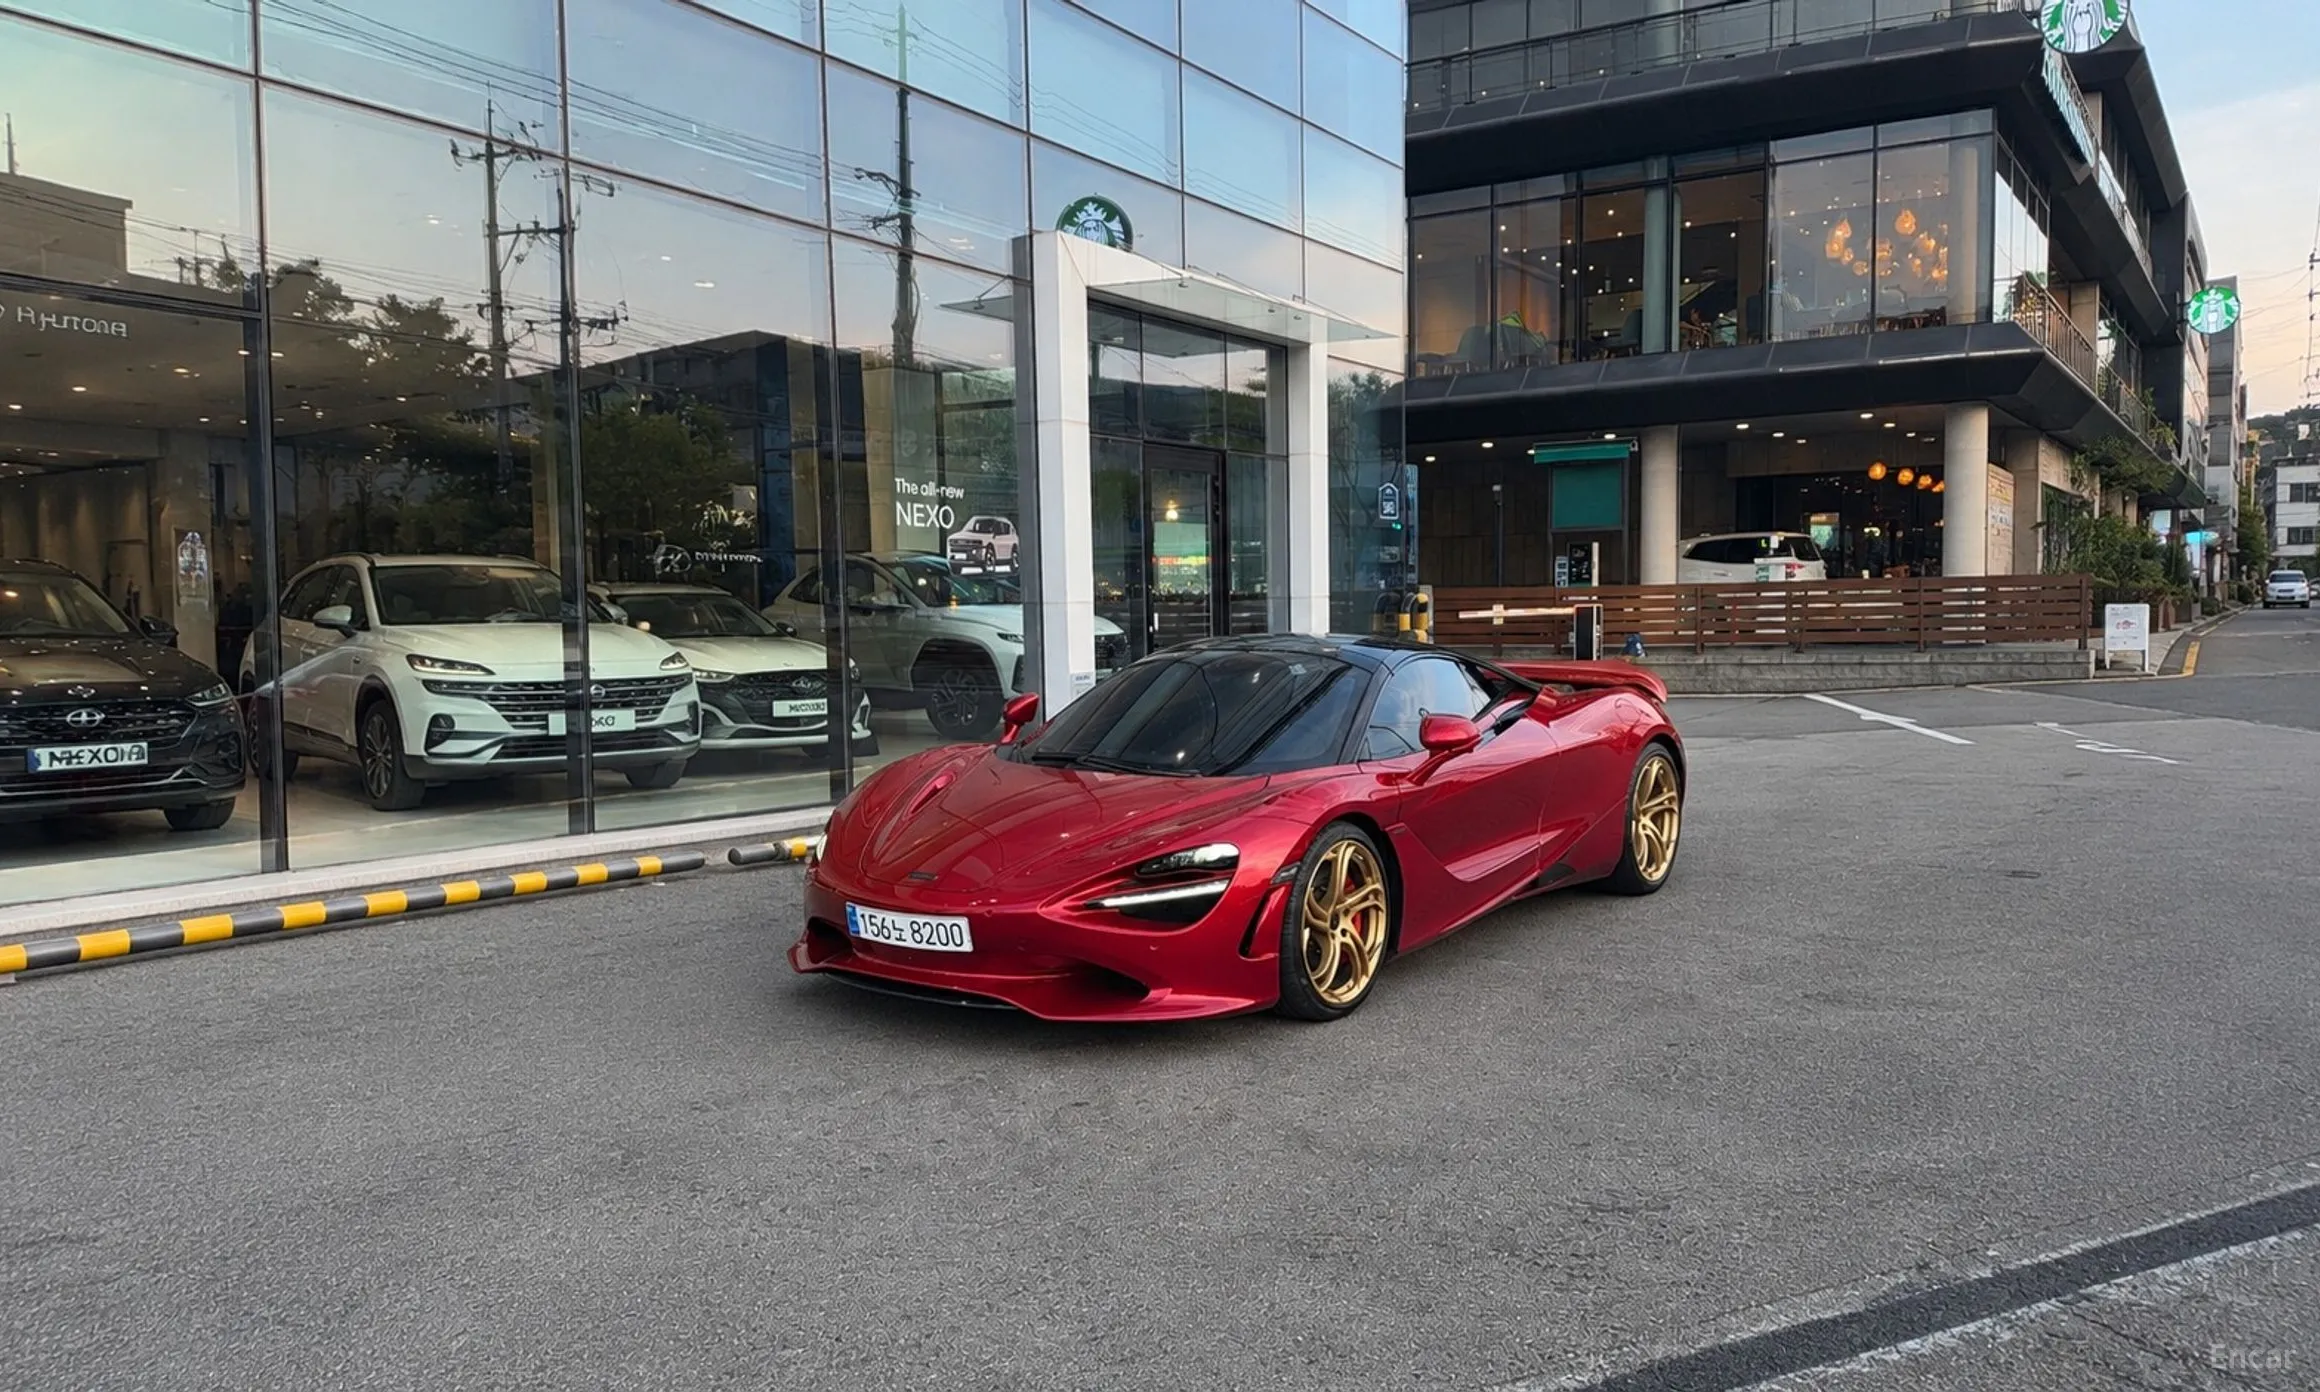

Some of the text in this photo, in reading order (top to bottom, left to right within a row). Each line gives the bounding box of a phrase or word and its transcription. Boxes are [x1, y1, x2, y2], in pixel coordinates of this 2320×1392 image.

[895, 478, 964, 499] The all-new
[896, 501, 955, 529] NEXO
[860, 913, 964, 947] 156노 8200
